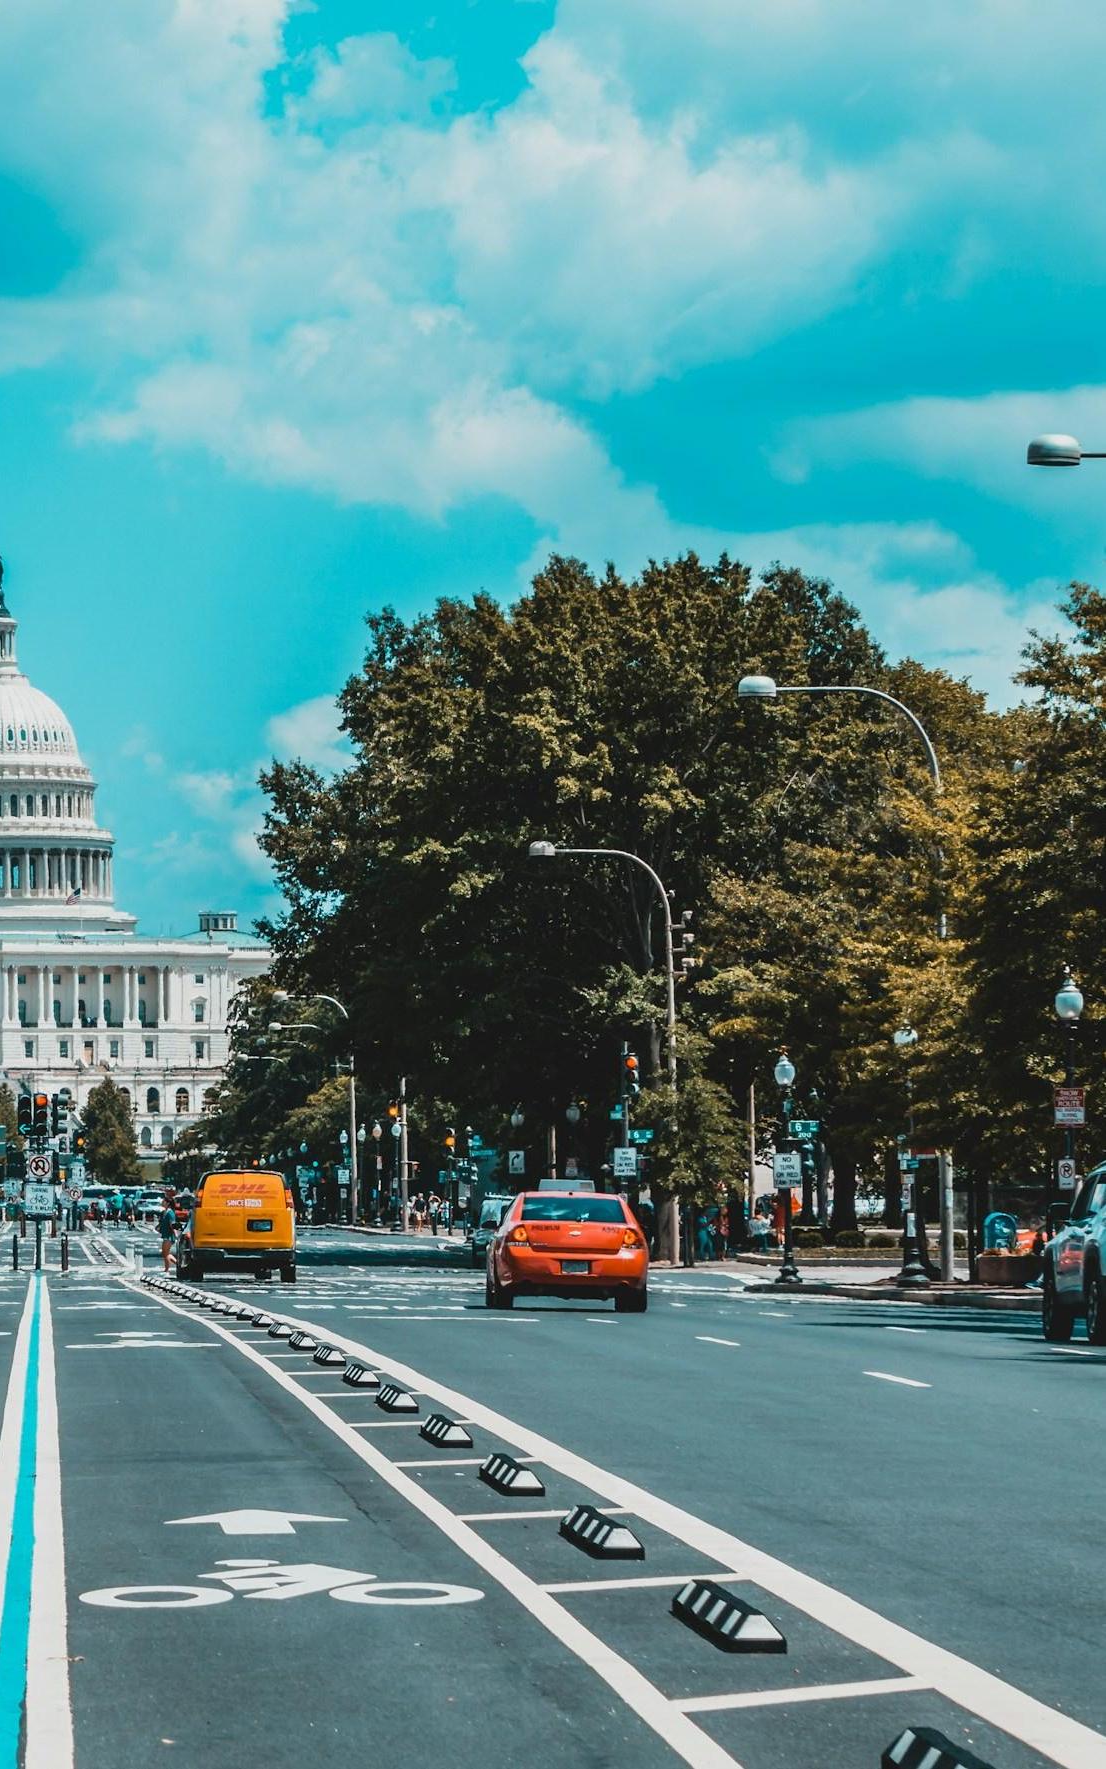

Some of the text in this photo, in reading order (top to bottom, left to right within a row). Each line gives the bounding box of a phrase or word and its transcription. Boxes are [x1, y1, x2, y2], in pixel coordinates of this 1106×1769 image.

[795, 1122, 802, 1131] 6
[634, 1130, 640, 1138] 6
[218, 1183, 269, 1194] DHL
[226, 1199, 245, 1207] SINCE
